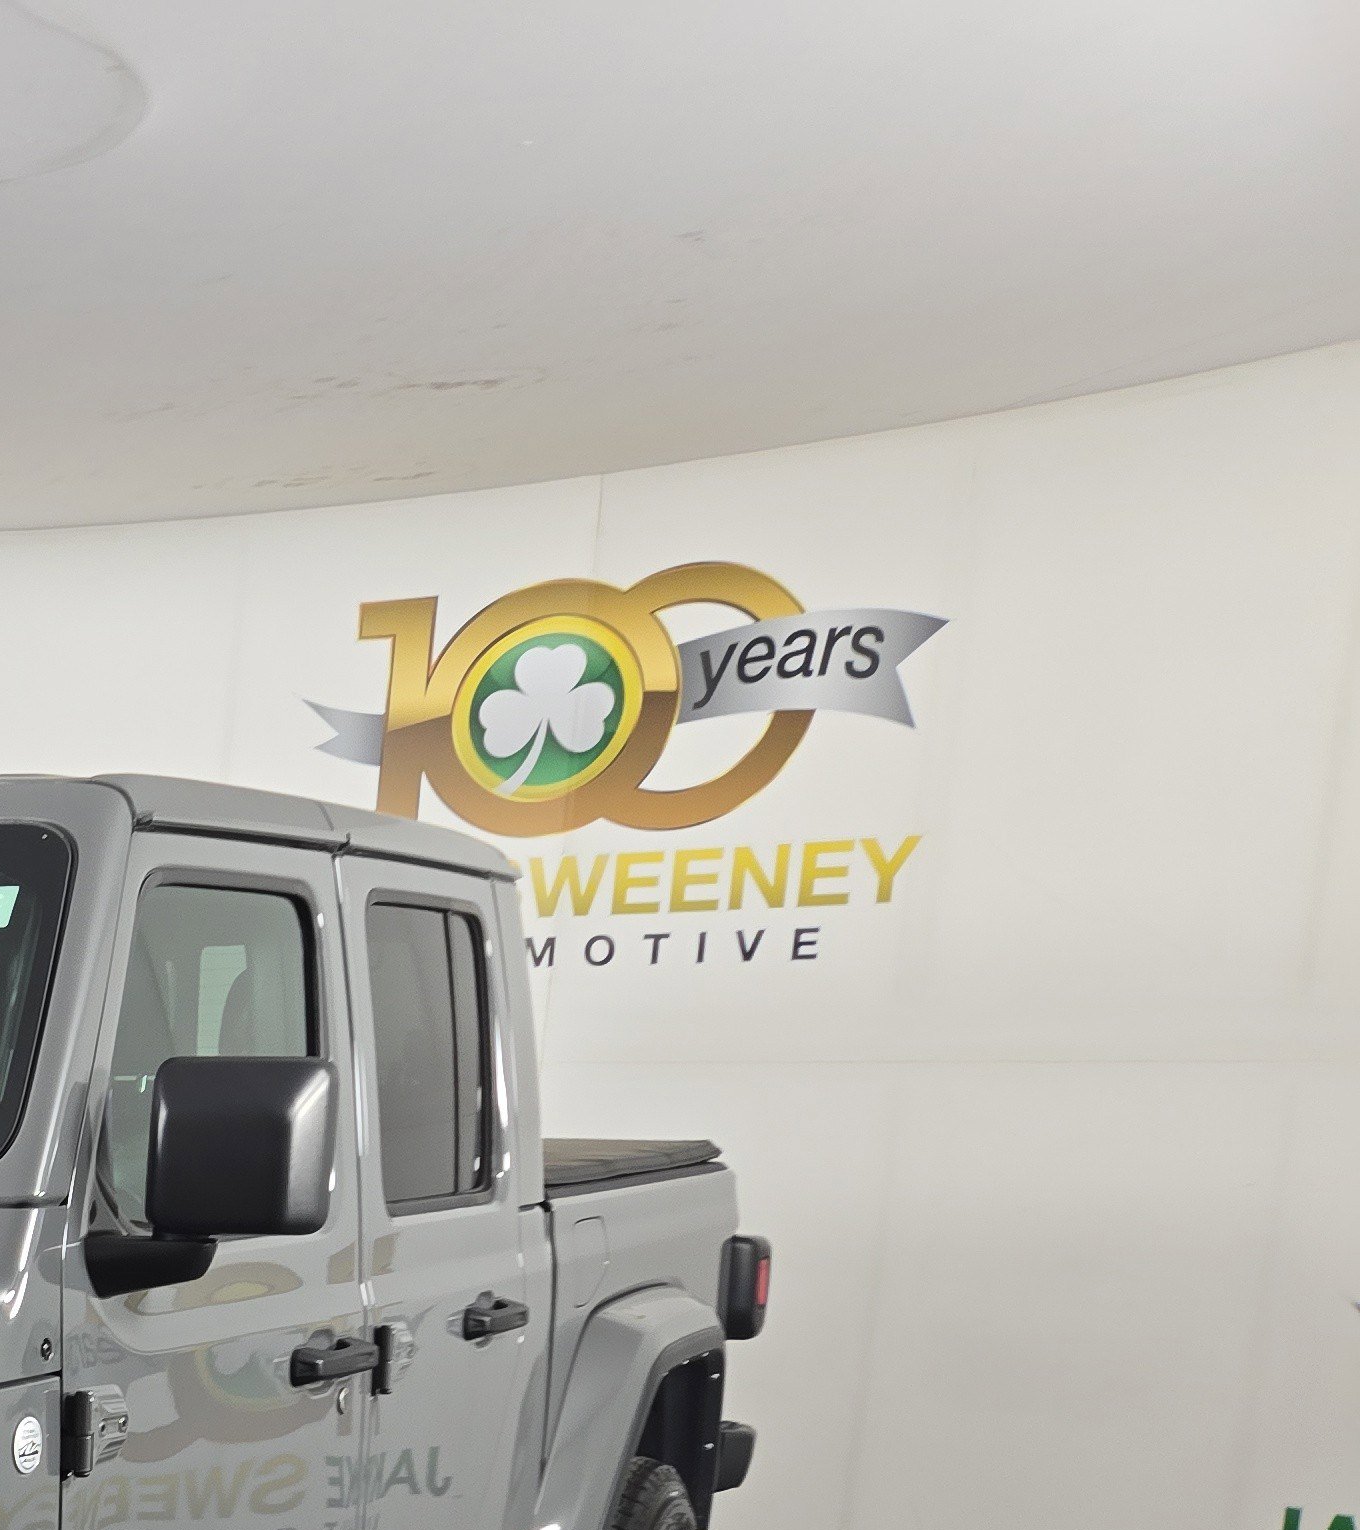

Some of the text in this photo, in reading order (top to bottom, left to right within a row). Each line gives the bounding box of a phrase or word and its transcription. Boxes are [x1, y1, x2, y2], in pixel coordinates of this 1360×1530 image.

[691, 623, 885, 711] years
[510, 834, 922, 918] WEENEY
[524, 925, 821, 968] MOTIVE
